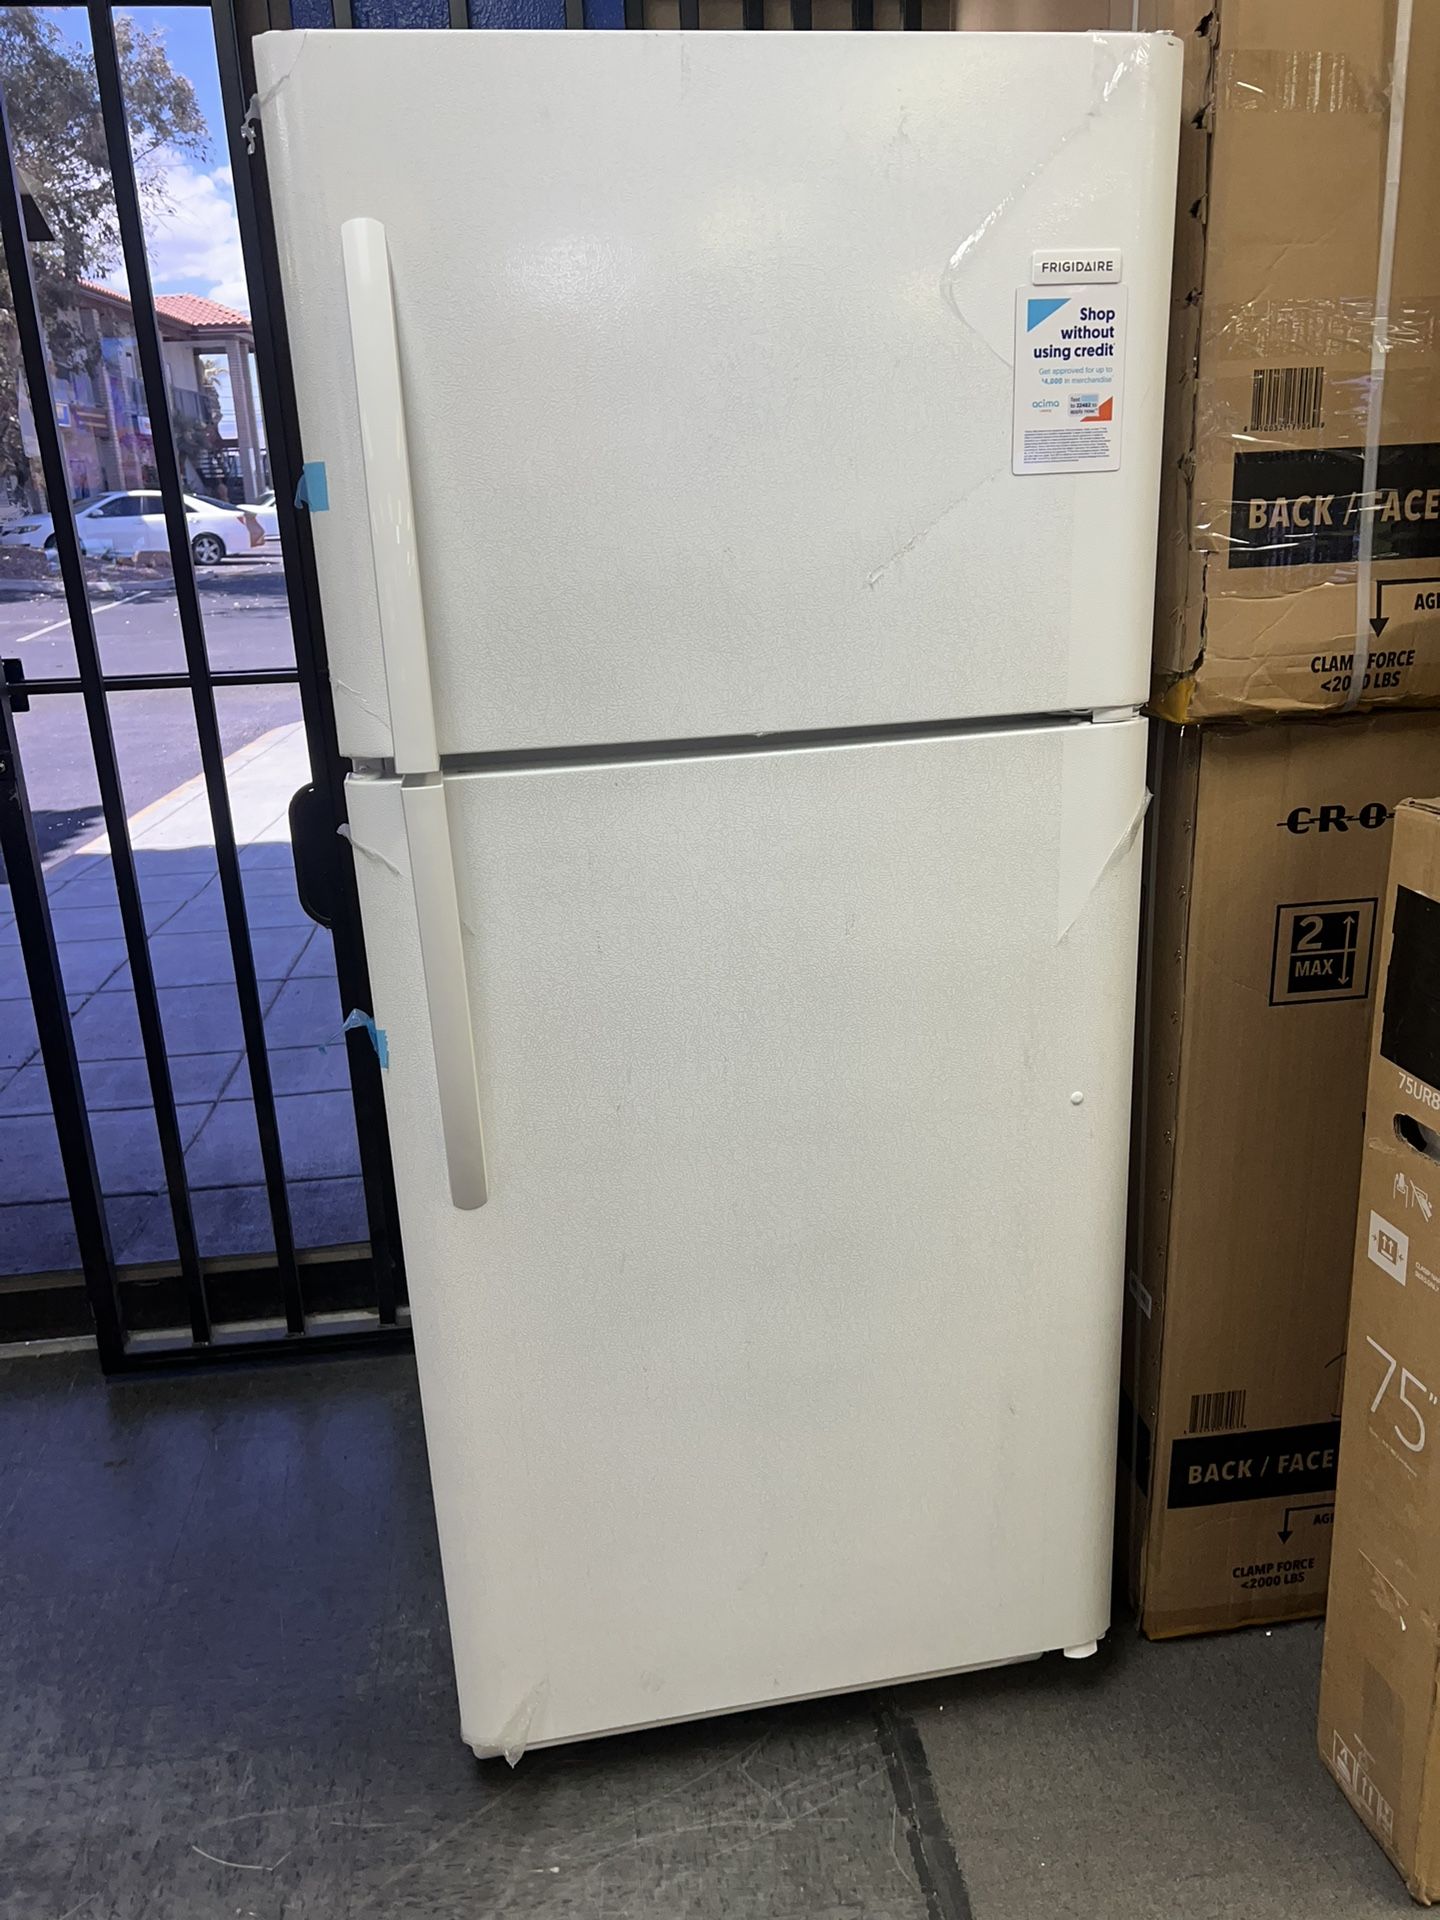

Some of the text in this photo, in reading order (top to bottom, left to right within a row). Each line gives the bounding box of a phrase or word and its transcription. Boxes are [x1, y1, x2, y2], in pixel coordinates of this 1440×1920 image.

[1042, 261, 1113, 273] FRIGIDAIRE
[1080, 307, 1115, 323] Shop
[1061, 325, 1114, 339] without
[1034, 342, 1114, 361] using credit
[1053, 367, 1084, 376] approved
[1085, 366, 1094, 374] for
[1032, 399, 1060, 408] acima
[1249, 494, 1335, 529] BACK
[1343, 491, 1356, 525] /
[1311, 649, 1416, 674] CLAM FORCE
[1320, 671, 1401, 693] <200 LBS
[1297, 915, 1323, 950] 2
[1295, 958, 1334, 977] MAX
[1188, 1449, 1335, 1485] BACK / FACE
[1232, 1557, 1315, 1578] CLAMP FORCE
[1240, 1571, 1305, 1589] <2000 LBS
